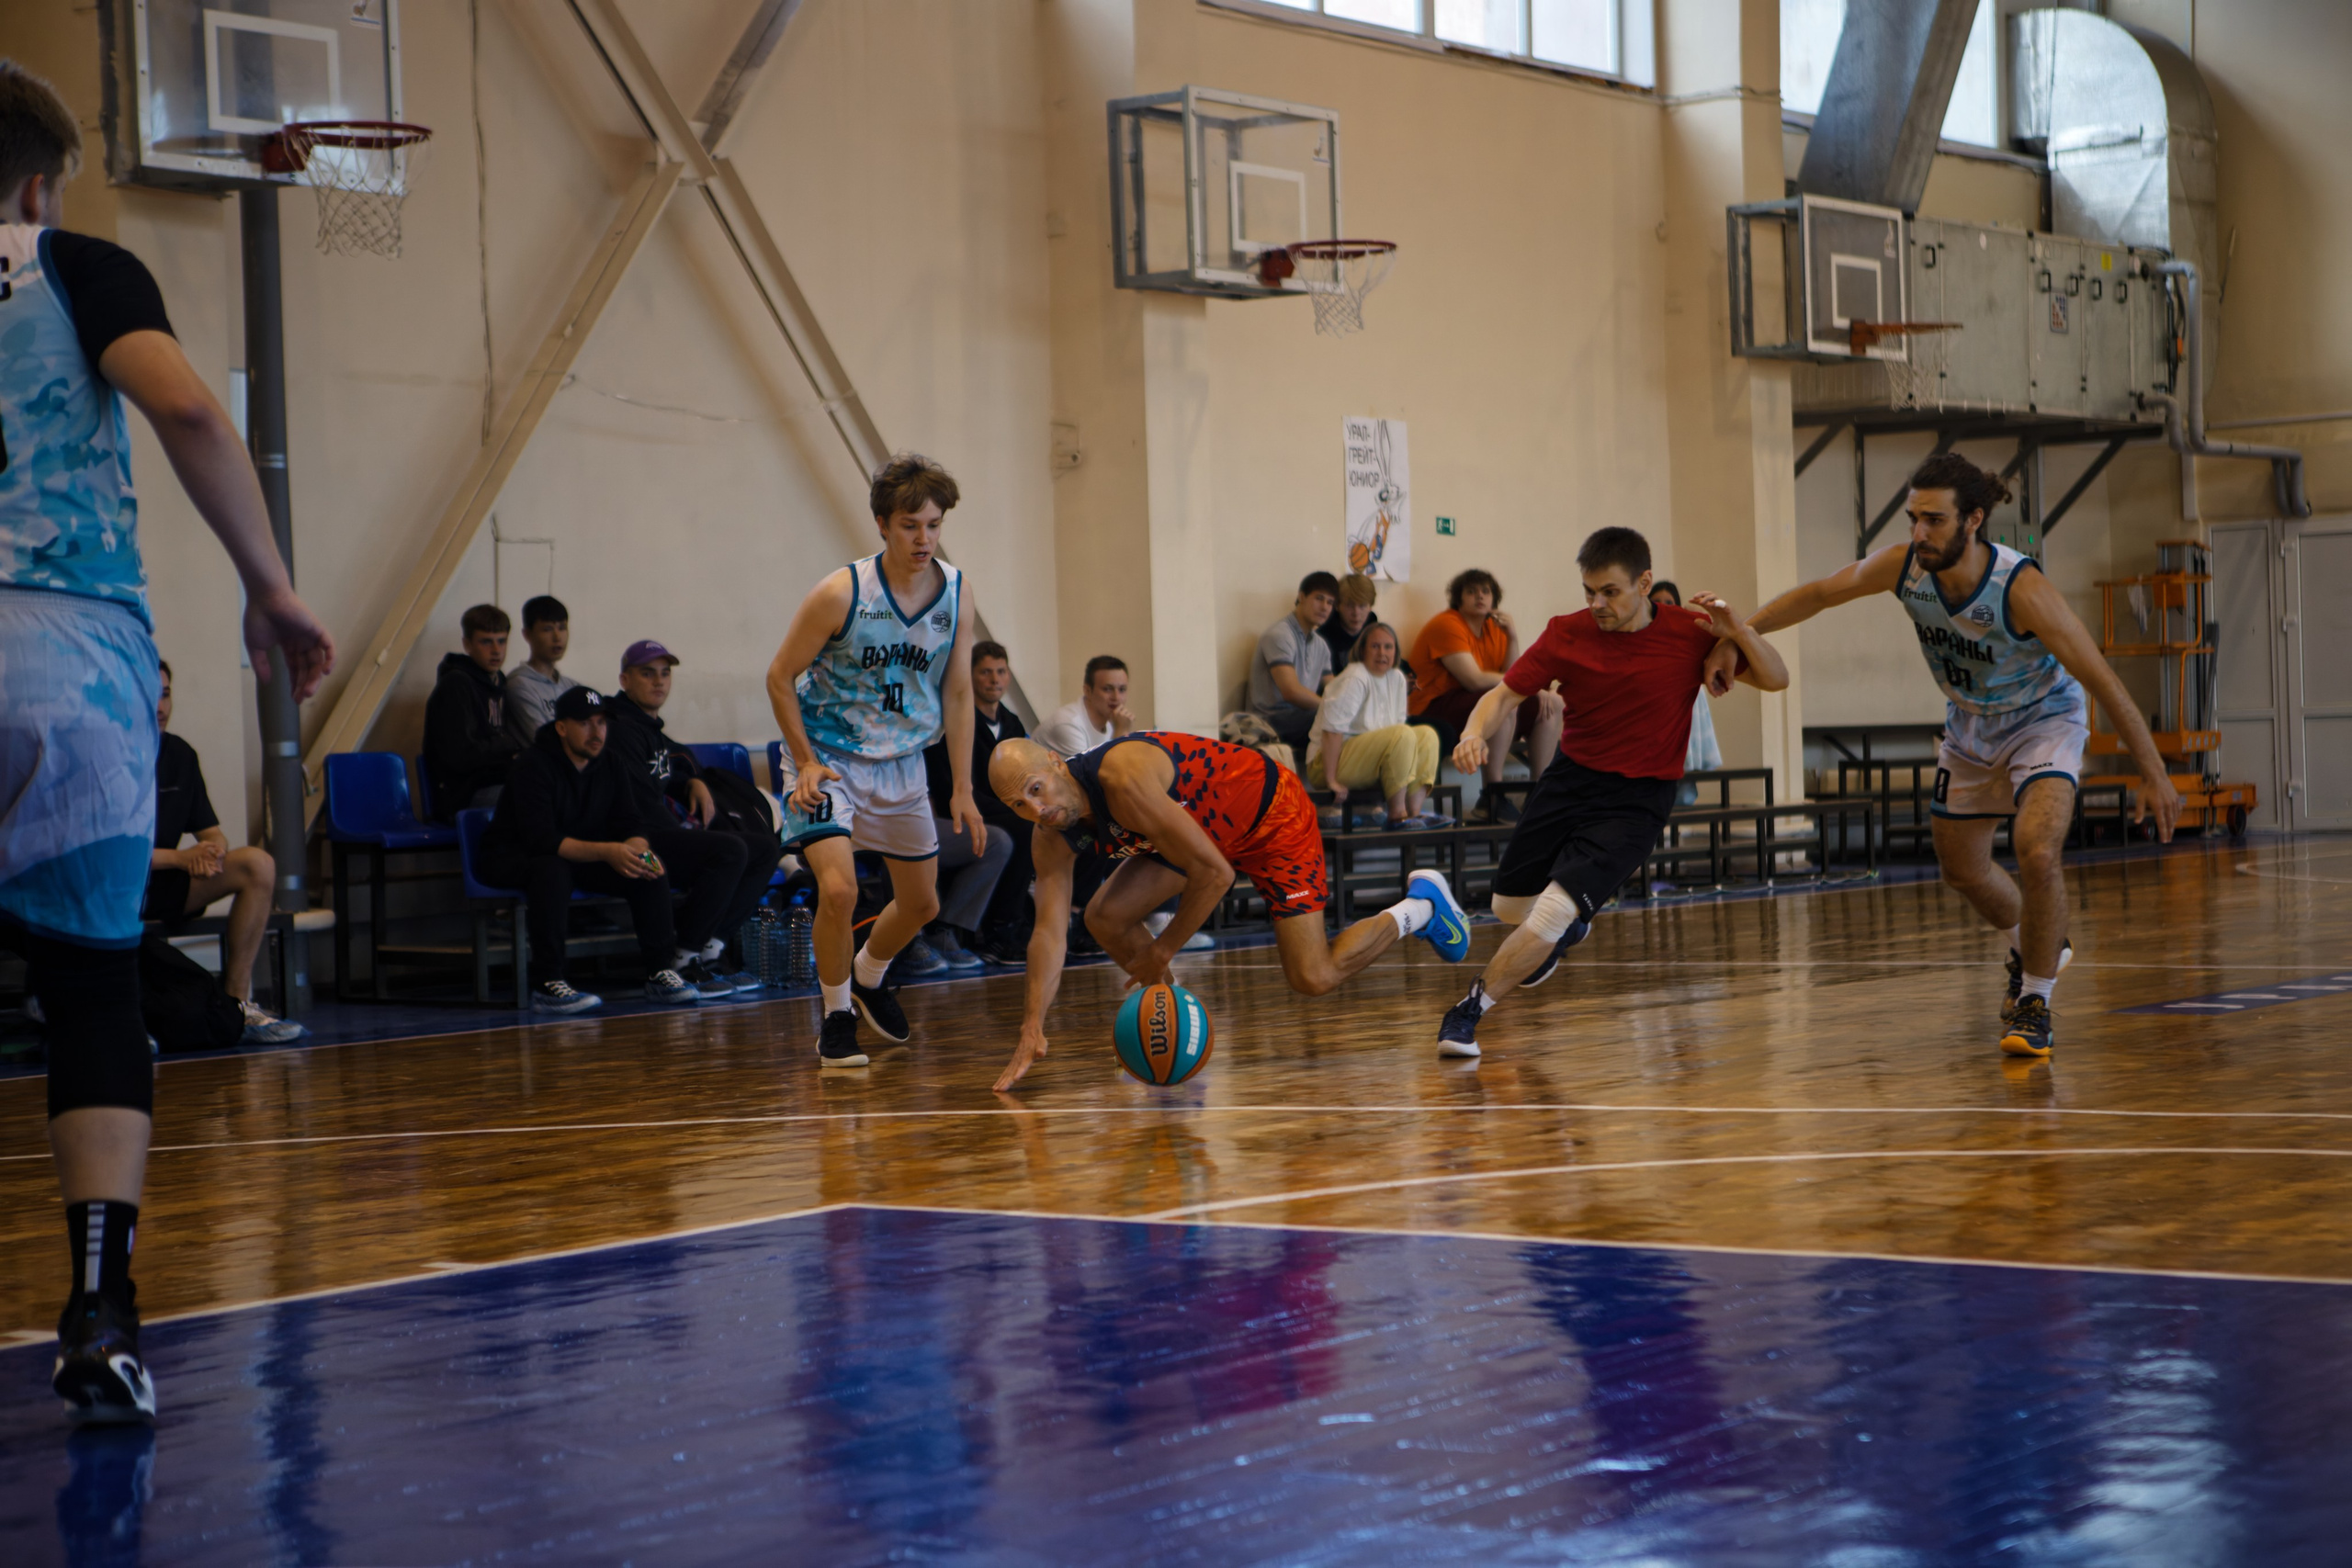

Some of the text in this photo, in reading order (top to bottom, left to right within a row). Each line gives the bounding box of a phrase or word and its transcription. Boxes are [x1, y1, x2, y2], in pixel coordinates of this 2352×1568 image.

[1346, 423, 1371, 440] УРАЛ-
[1349, 470, 1379, 488] ЮНИОР
[859, 608, 893, 621] fruitit
[861, 641, 936, 673] ВАРАНЫ
[882, 682, 903, 714] 10
[1286, 889, 1309, 900] MAXX
[1148, 990, 1169, 1056] Wilson
